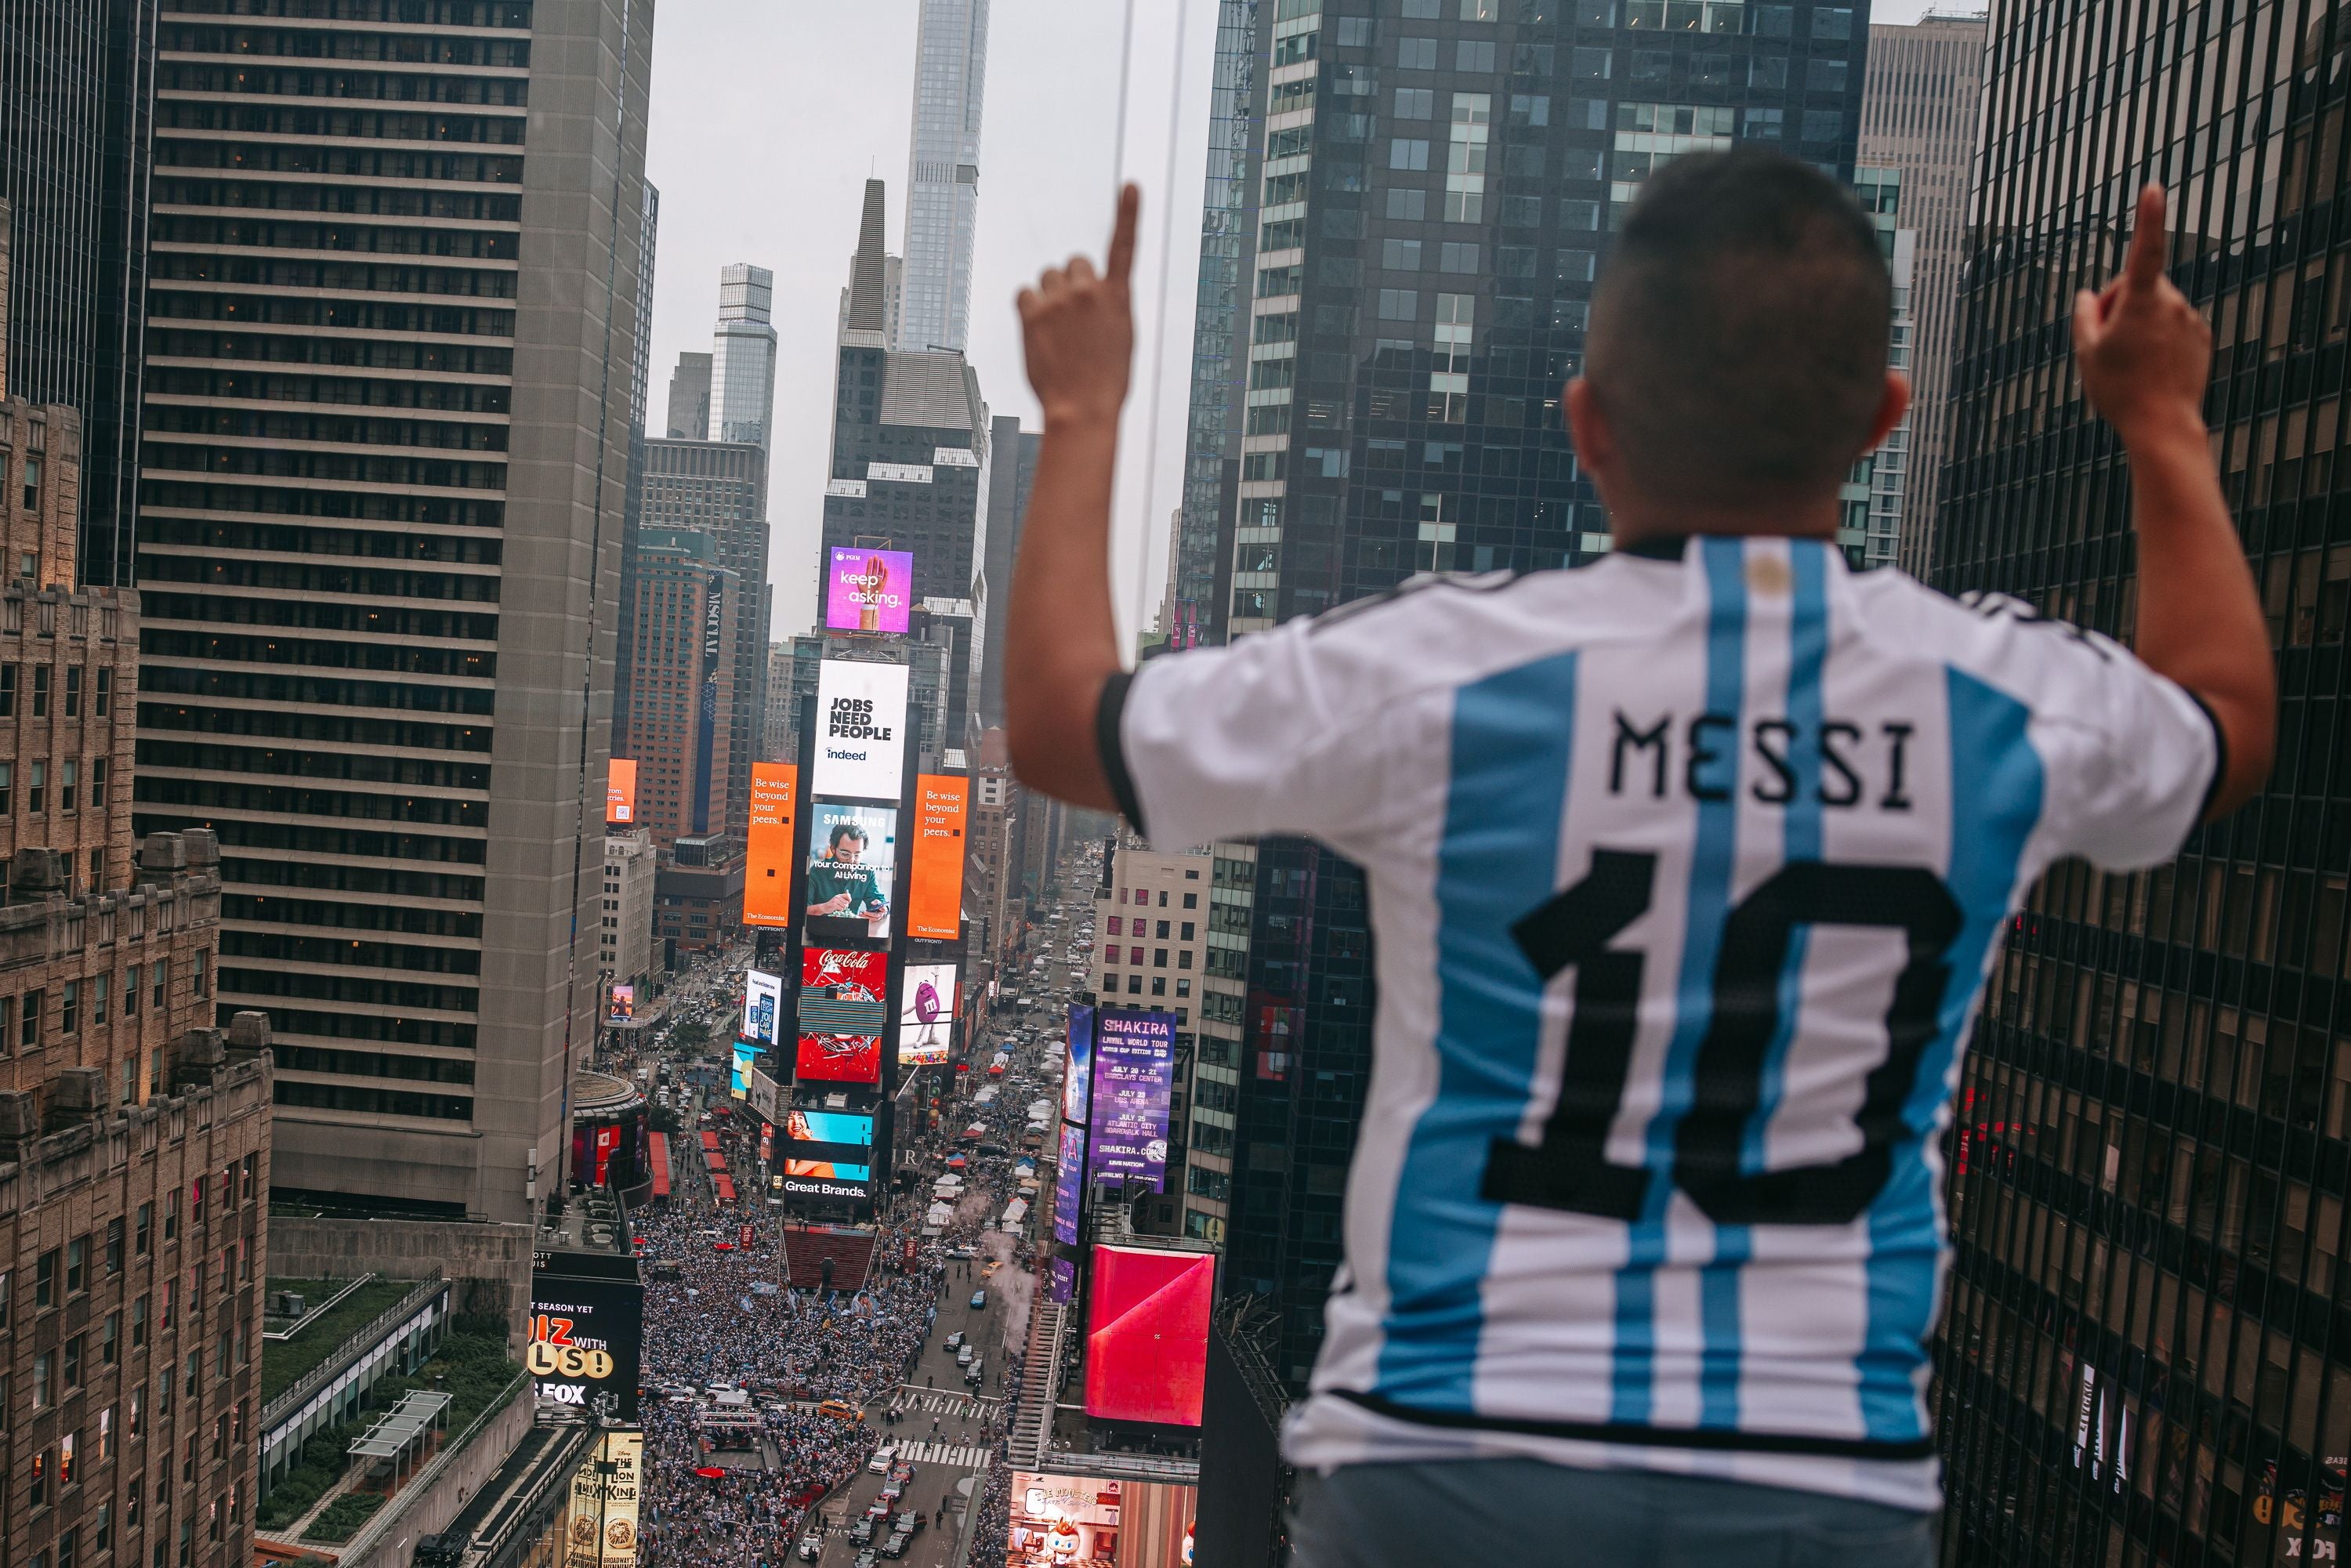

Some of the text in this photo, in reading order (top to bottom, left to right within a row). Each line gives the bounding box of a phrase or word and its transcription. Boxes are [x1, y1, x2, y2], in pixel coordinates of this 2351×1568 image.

[840, 570, 878, 589] keep
[848, 589, 902, 608] asking.
[831, 697, 873, 712] JOBS
[830, 711, 871, 726] NEED
[829, 724, 891, 741] PEOPLE
[826, 748, 866, 761] indeed
[1608, 704, 1914, 812] MESSI
[755, 778, 789, 789] Be wise
[755, 790, 788, 801] beyond
[926, 790, 961, 801] Be wise
[753, 804, 775, 813] your
[926, 802, 959, 814] beyond
[752, 816, 780, 825] peers.
[824, 814, 886, 827] SAMSUNG
[925, 817, 946, 825] your
[923, 828, 951, 838] peers.
[831, 861, 880, 872] Companion
[843, 871, 867, 882] Living
[761, 1012, 773, 1023] YOU
[1104, 1019, 1168, 1035] SHAKIRA
[1479, 845, 1967, 1226] 10
[1128, 1038, 1147, 1047] WORLD
[1104, 1072, 1136, 1081] BARCLAYS
[1107, 1120, 1138, 1128] ATLANTIC
[1104, 1127, 1139, 1136] BOARDWALK
[1099, 1144, 1157, 1156] SHAKIRA.COM
[785, 1180, 867, 1197] Great Brands.
[538, 1302, 574, 1313] SEASON
[577, 1305, 593, 1313] YET
[574, 1336, 607, 1351] WITH
[542, 1382, 586, 1405] FOX
[614, 1458, 632, 1467] THE
[611, 1472, 635, 1483] LION
[1035, 1488, 1052, 1501] THE
[1056, 1488, 1099, 1505] MONSTERS
